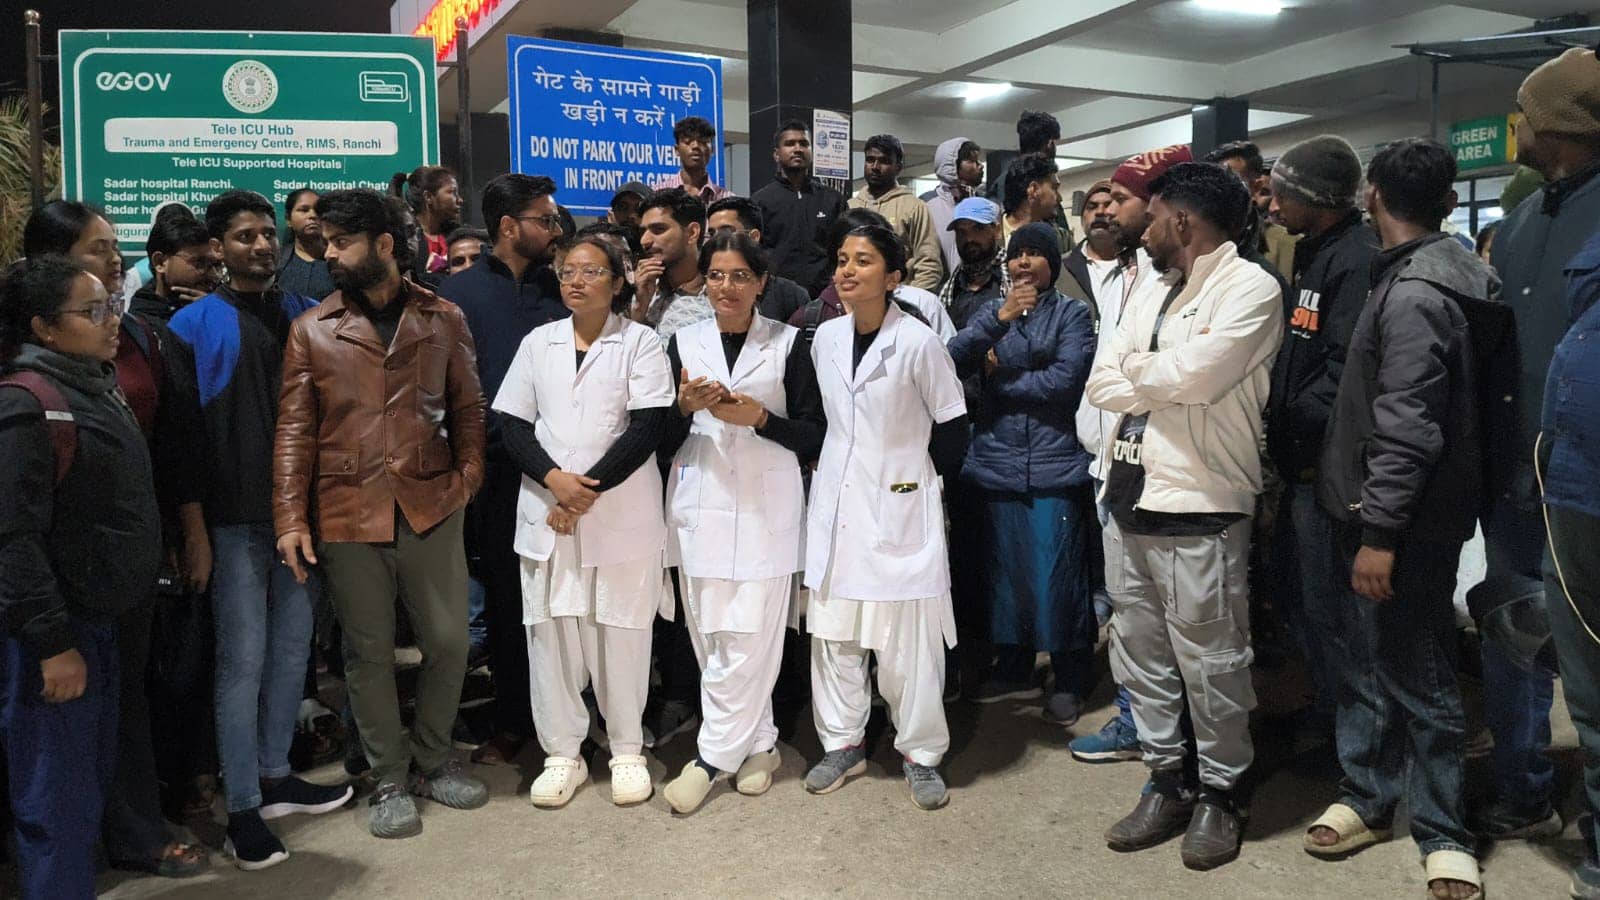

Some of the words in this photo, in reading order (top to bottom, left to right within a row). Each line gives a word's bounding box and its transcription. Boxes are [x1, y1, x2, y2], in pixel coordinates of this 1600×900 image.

[532, 66, 565, 90] गेट
[570, 70, 593, 93] के
[599, 76, 652, 98] सामने
[657, 82, 702, 107] गाड़ी
[560, 100, 607, 126] खड़ी
[612, 107, 627, 124] न
[632, 105, 665, 130] करें
[211, 124, 237, 135] Tele
[241, 124, 264, 135] ICU
[268, 125, 294, 135] Hub
[1451, 126, 1498, 145] GREEN
[122, 137, 165, 147] Trauma
[168, 137, 190, 147] and
[193, 137, 257, 149] Emergency
[261, 138, 302, 150] Centre,
[306, 138, 340, 150] RIMS,
[343, 139, 382, 149] Ranchi
[530, 136, 549, 158] DO
[553, 137, 579, 160] NOT
[583, 139, 617, 163] PARK
[619, 142, 653, 165] YOUR
[656, 144, 681, 166] VEH
[1456, 144, 1493, 161] AREA
[172, 157, 197, 167] Tele
[200, 158, 220, 168] ICU
[223, 158, 285, 170] Supported
[288, 158, 342, 171] Hospitals
[103, 178, 138, 188] Sadar
[141, 178, 188, 190] hospital
[191, 178, 234, 189] Ranchi.
[273, 180, 307, 190] Sadar
[310, 180, 356, 191] hospital
[565, 168, 577, 188] IN
[582, 168, 624, 191] FRONT
[104, 191, 138, 201] Sadar
[141, 191, 188, 202] hospital
[104, 204, 139, 215] Sadar
